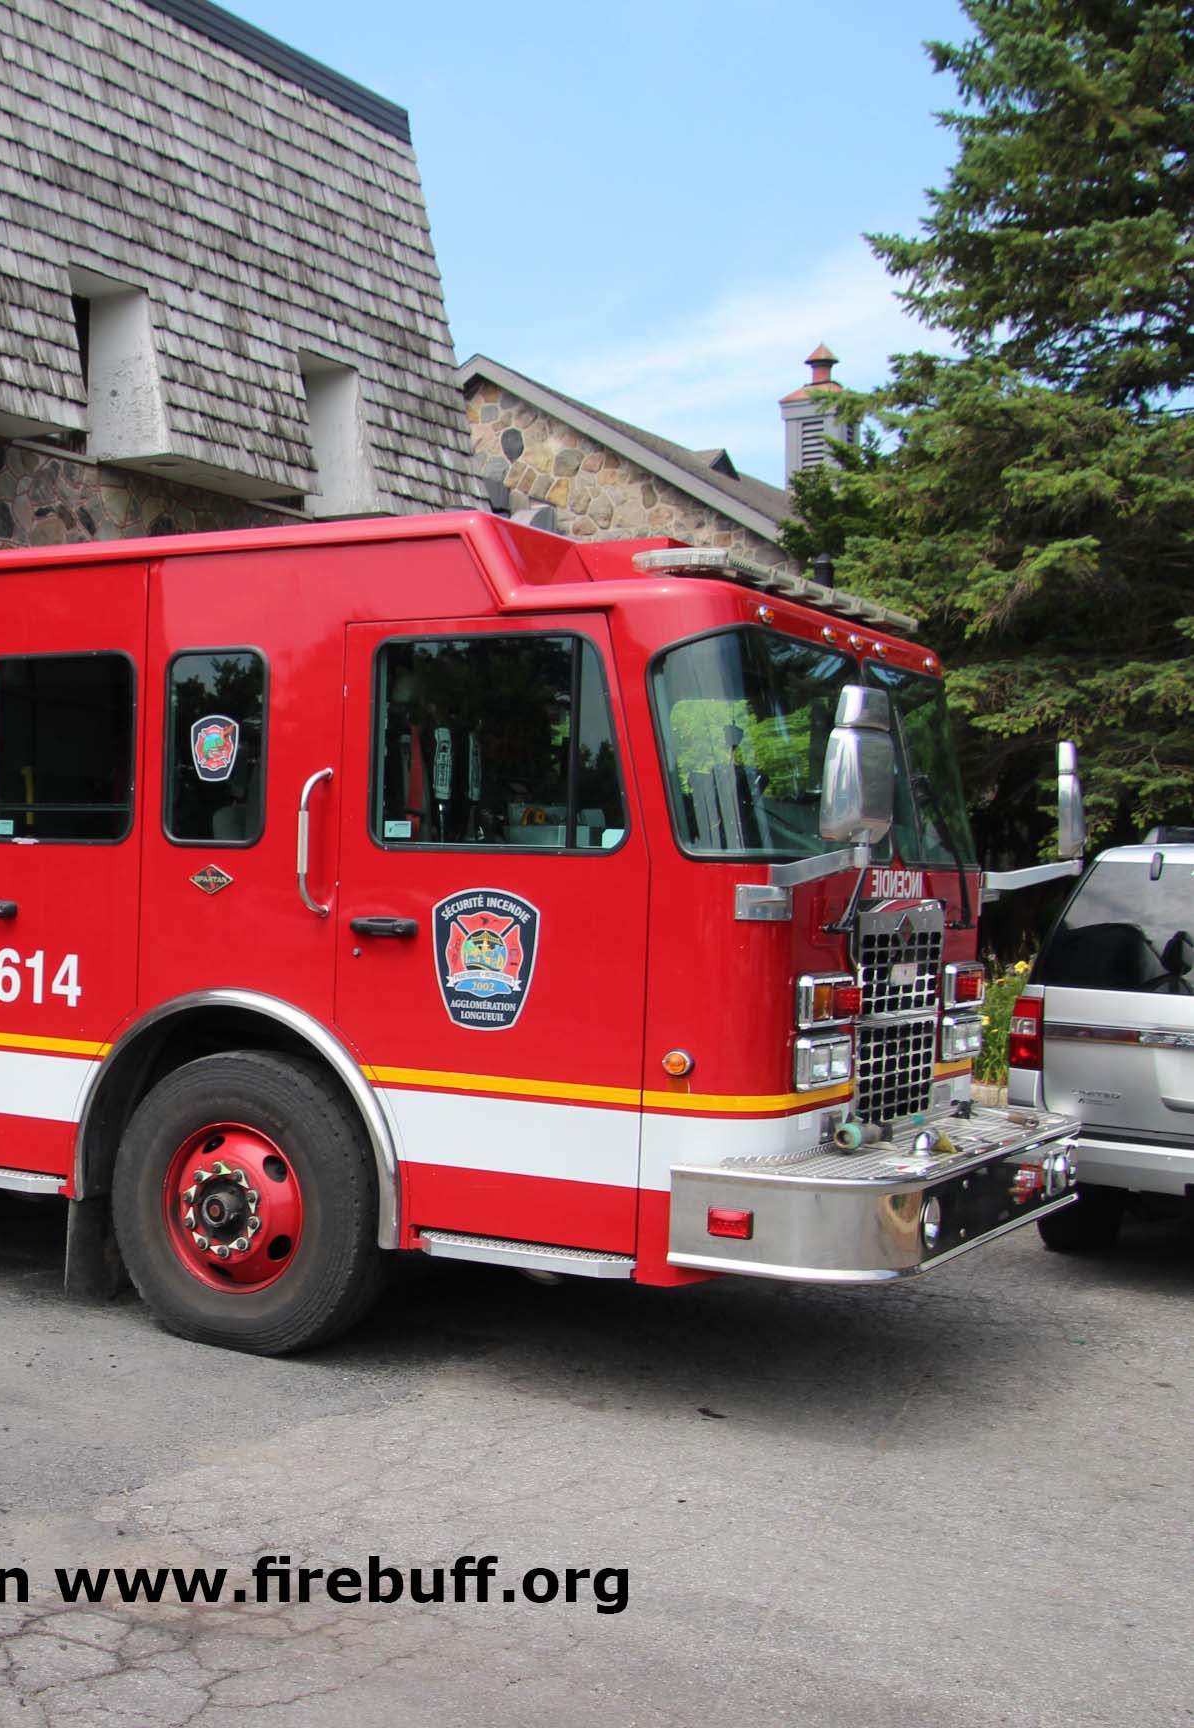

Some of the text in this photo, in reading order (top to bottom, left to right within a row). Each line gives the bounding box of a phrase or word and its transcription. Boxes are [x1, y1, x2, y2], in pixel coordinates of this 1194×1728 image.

[441, 895, 531, 924] SÉCURITÉ INCENDIE
[450, 999, 517, 1012] AGGLOMÉRATION
[460, 1010, 505, 1022] LONGUEUIL
